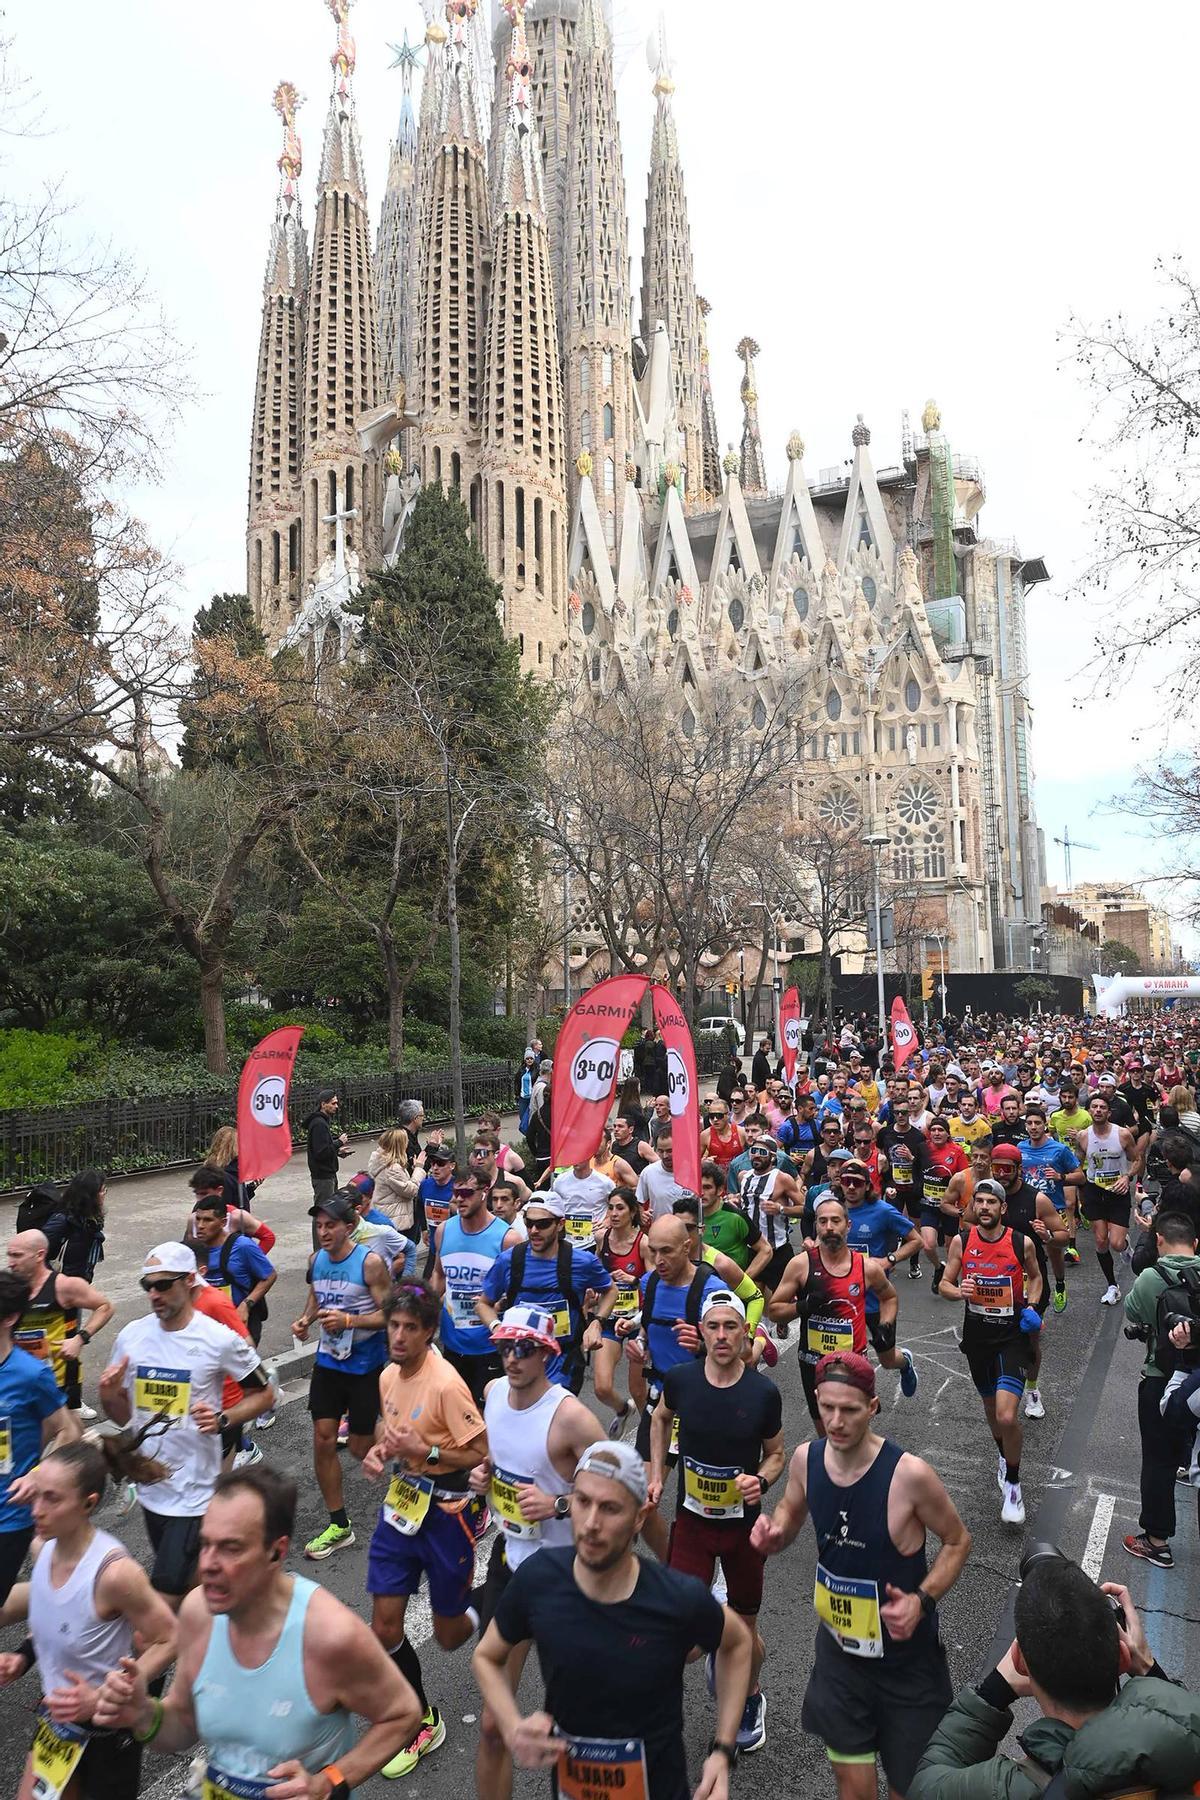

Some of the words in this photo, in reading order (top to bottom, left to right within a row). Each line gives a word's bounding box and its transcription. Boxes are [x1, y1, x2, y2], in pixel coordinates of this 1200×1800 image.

[1153, 980, 1189, 989] YAMAHA
[575, 1004, 636, 1019] GARMIN
[976, 1286, 1004, 1297] SERGIO
[821, 1333, 839, 1345] JOEL
[704, 1469, 728, 1478] ZURICH
[697, 1478, 727, 1493] DAVID
[830, 1582, 858, 1594] ZURICH
[830, 1595, 853, 1616] BEN
